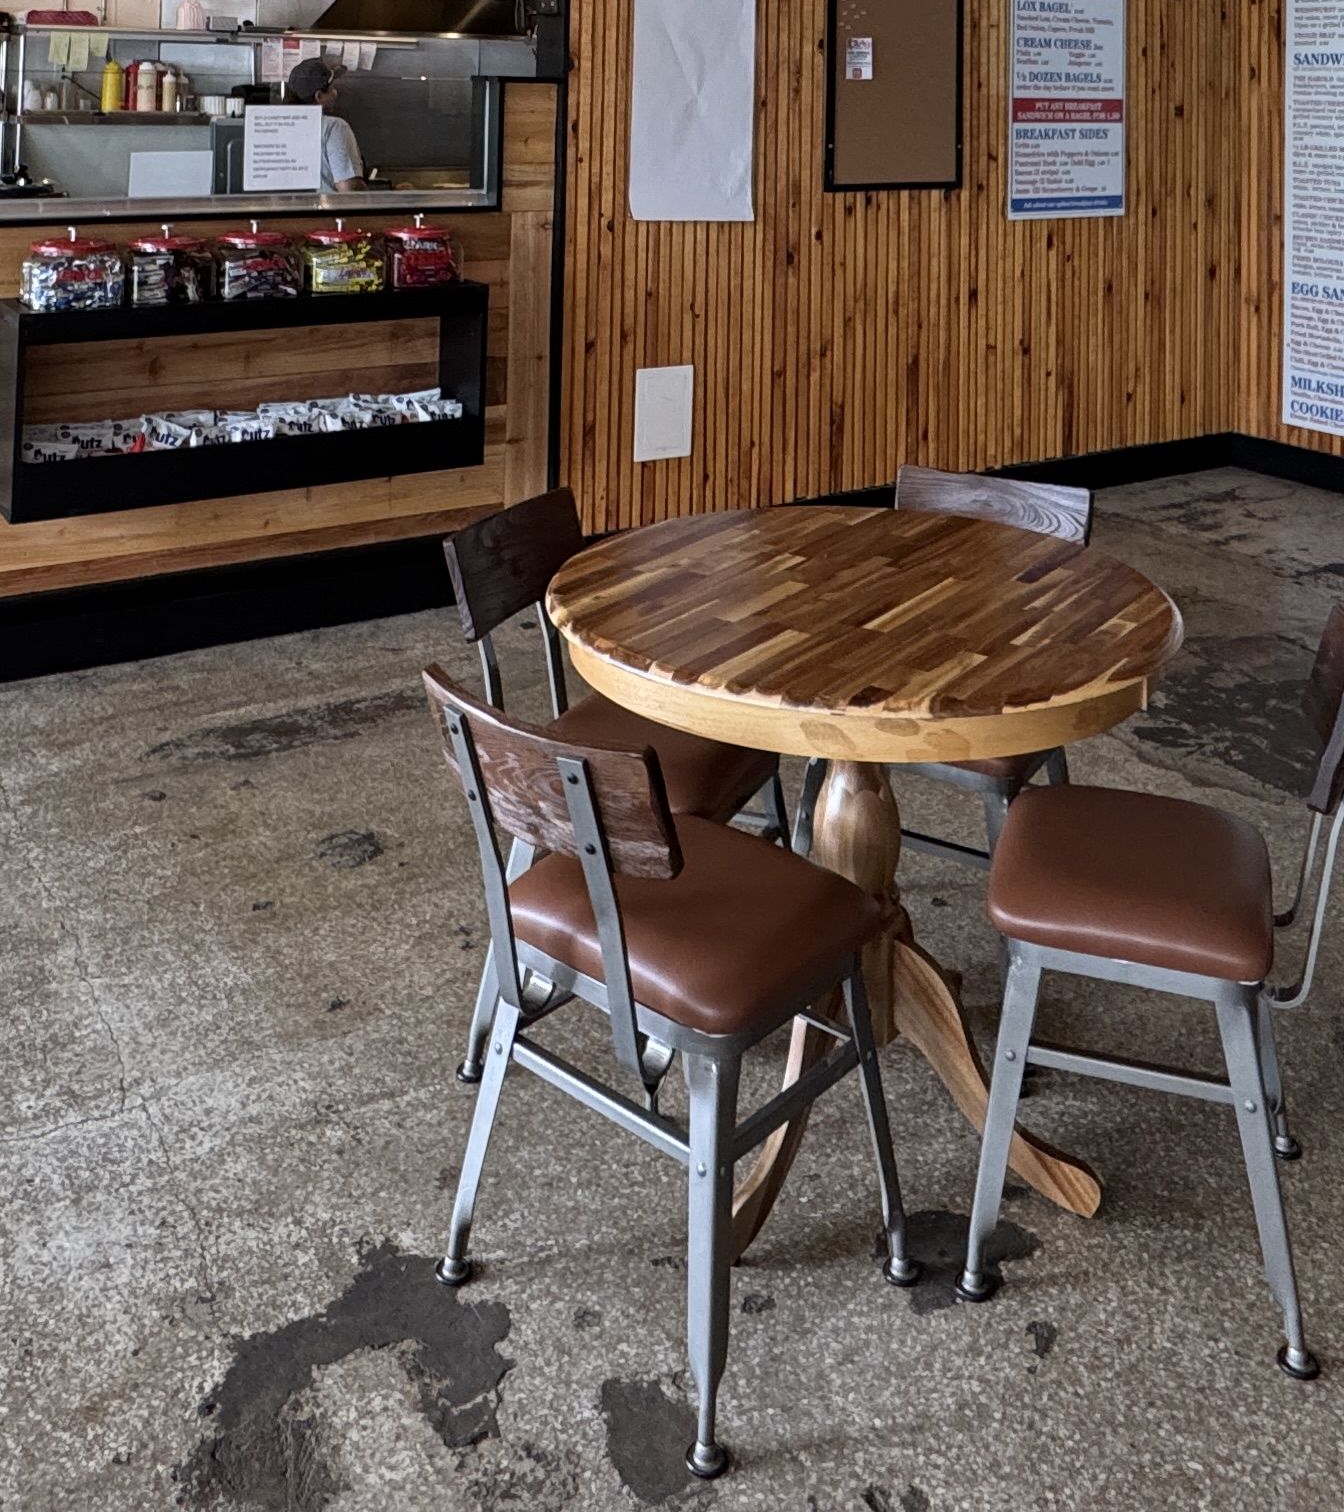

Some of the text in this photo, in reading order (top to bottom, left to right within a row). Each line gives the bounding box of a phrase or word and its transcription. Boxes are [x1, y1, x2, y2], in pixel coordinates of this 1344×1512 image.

[1017, 0, 1071, 14] LOX BAGEL
[1016, 37, 1093, 50] CREAM CHEESE
[1029, 72, 1062, 82] DOZEN
[1065, 73, 1102, 83] BAGELS
[1015, 128, 1077, 140] BREAKFAST
[1291, 282, 1319, 298] EGG
